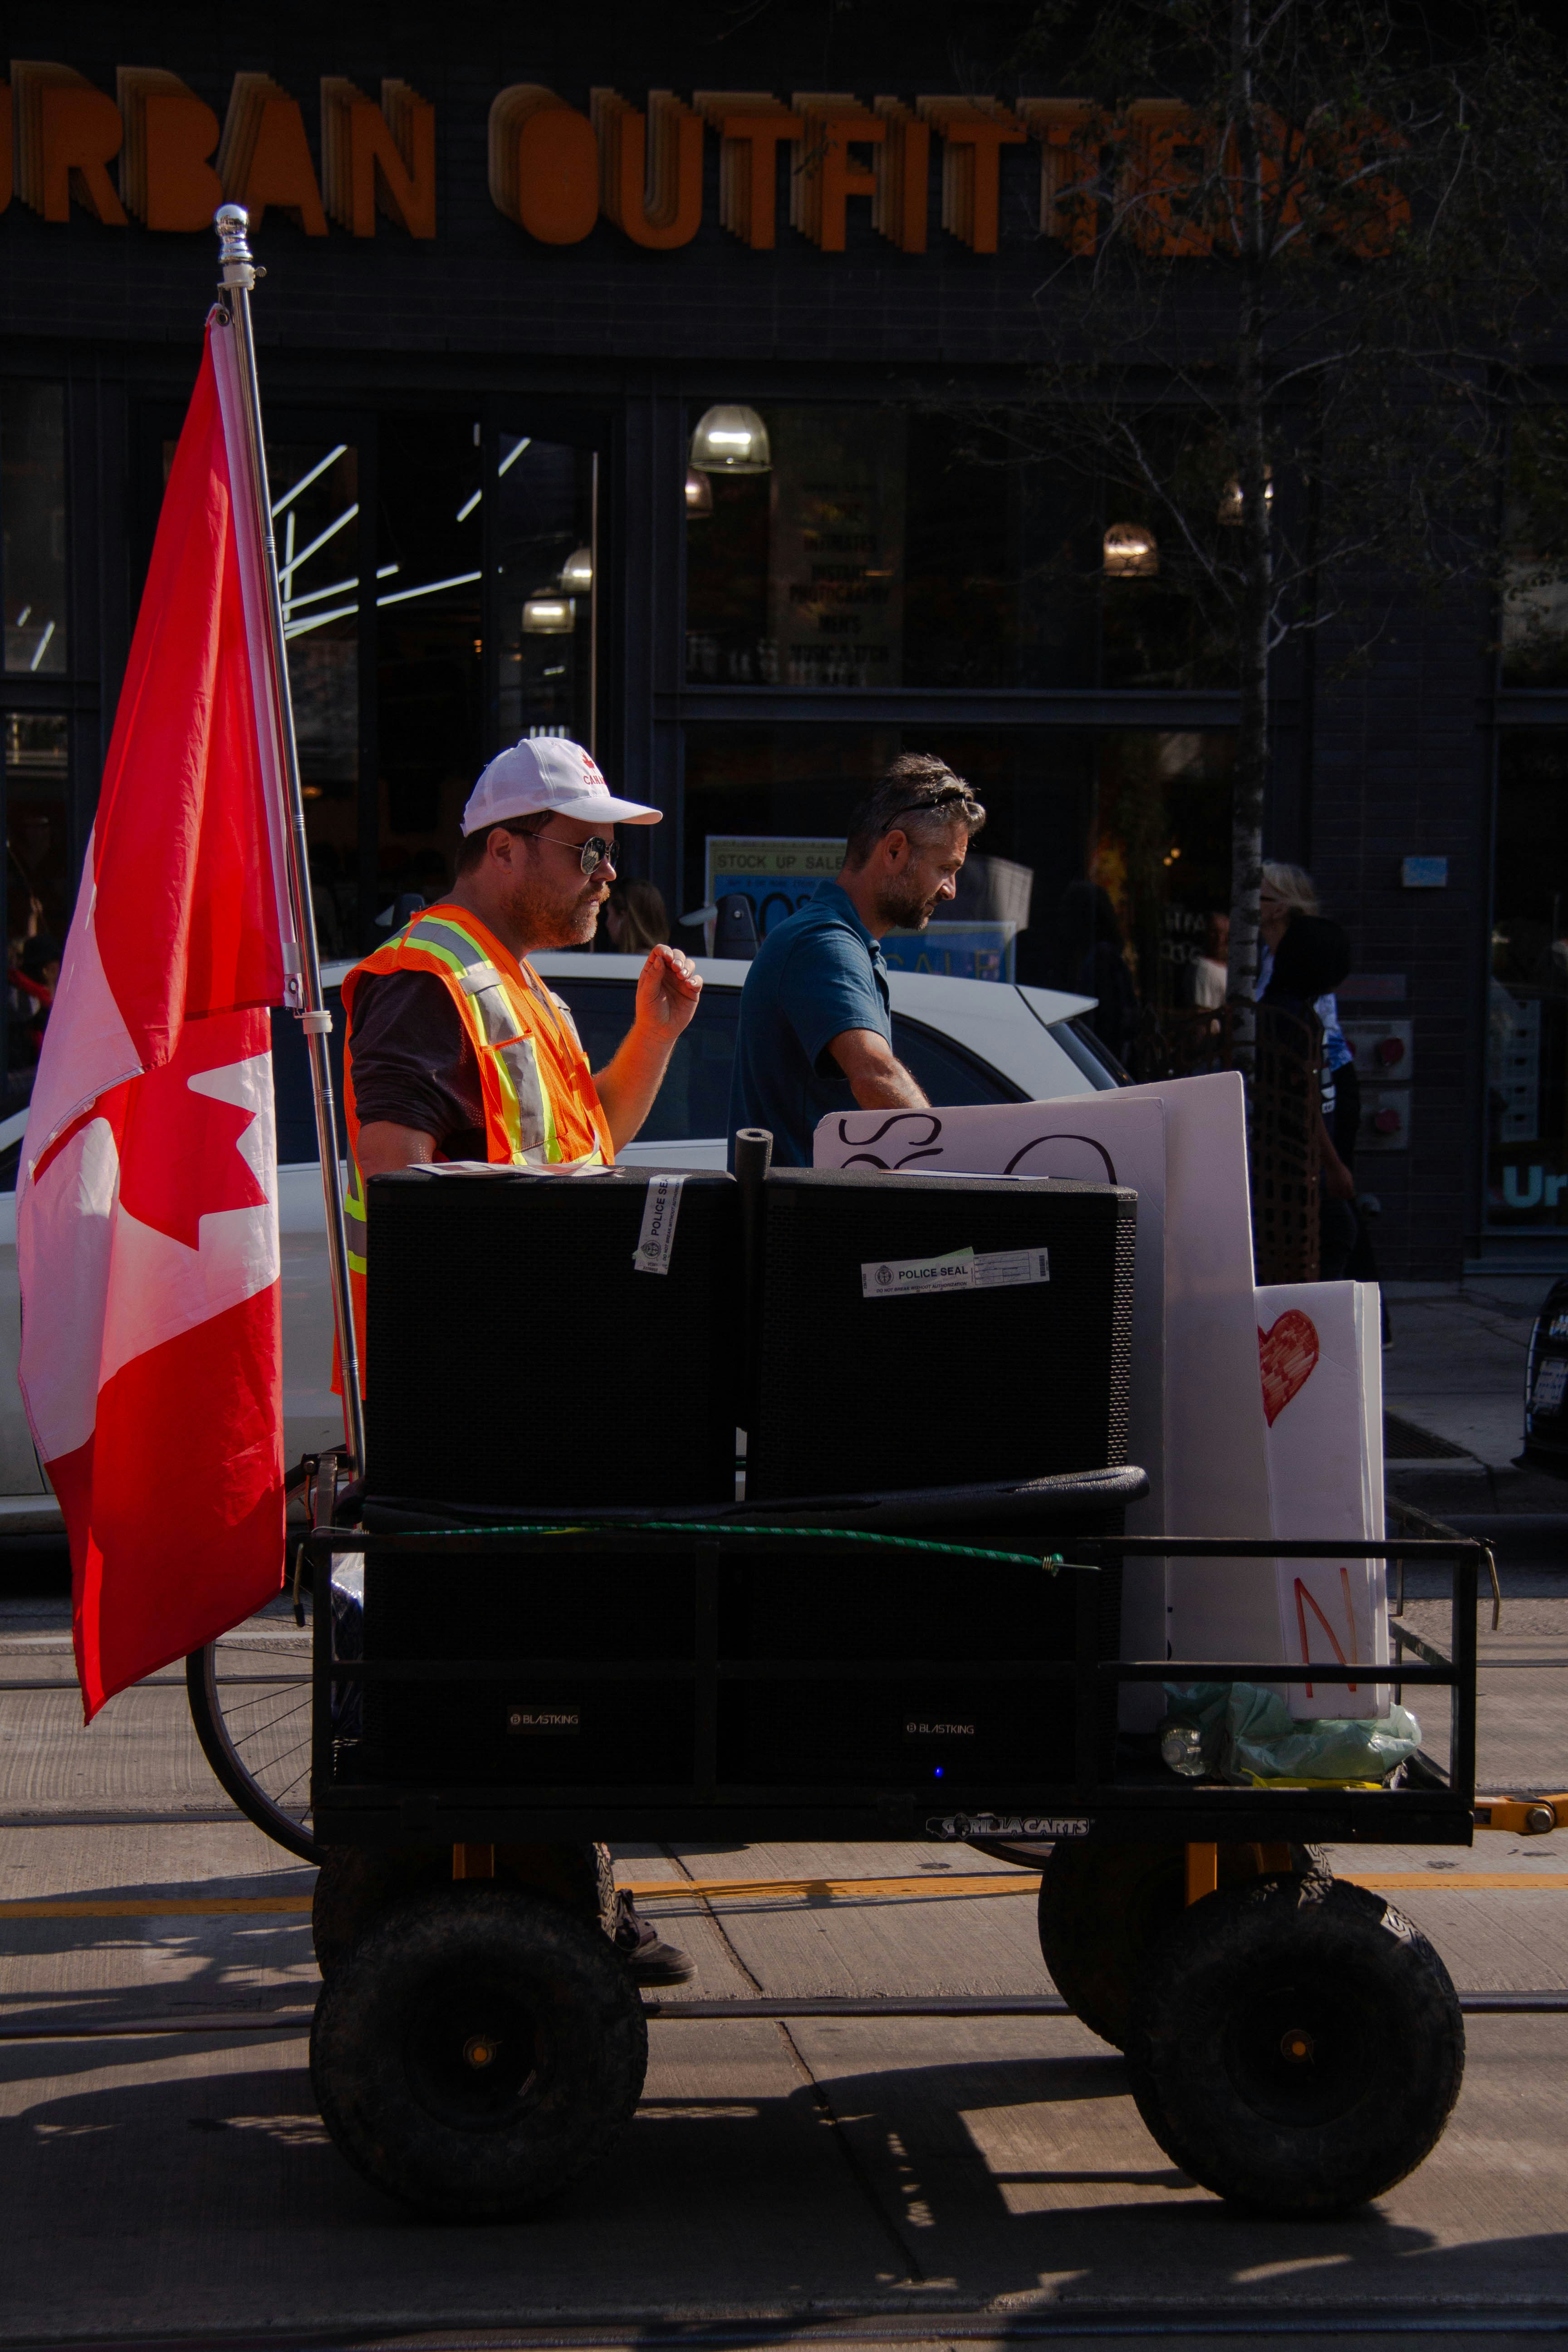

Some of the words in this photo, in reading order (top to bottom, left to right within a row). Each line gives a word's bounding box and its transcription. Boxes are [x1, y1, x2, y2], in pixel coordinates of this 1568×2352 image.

[0, 59, 436, 240] RBAN
[583, 775, 606, 784] CANA
[717, 854, 766, 868] STOCK
[775, 856, 796, 868] UP
[805, 856, 846, 870] SALE
[651, 1198, 665, 1236] POLICE
[658, 1178, 668, 1195] SEA
[899, 1269, 937, 1279] POLICE
[941, 1266, 968, 1276] SEAL
[523, 1713, 578, 1724] BLASTKING
[919, 1724, 974, 1735] BLASTKING
